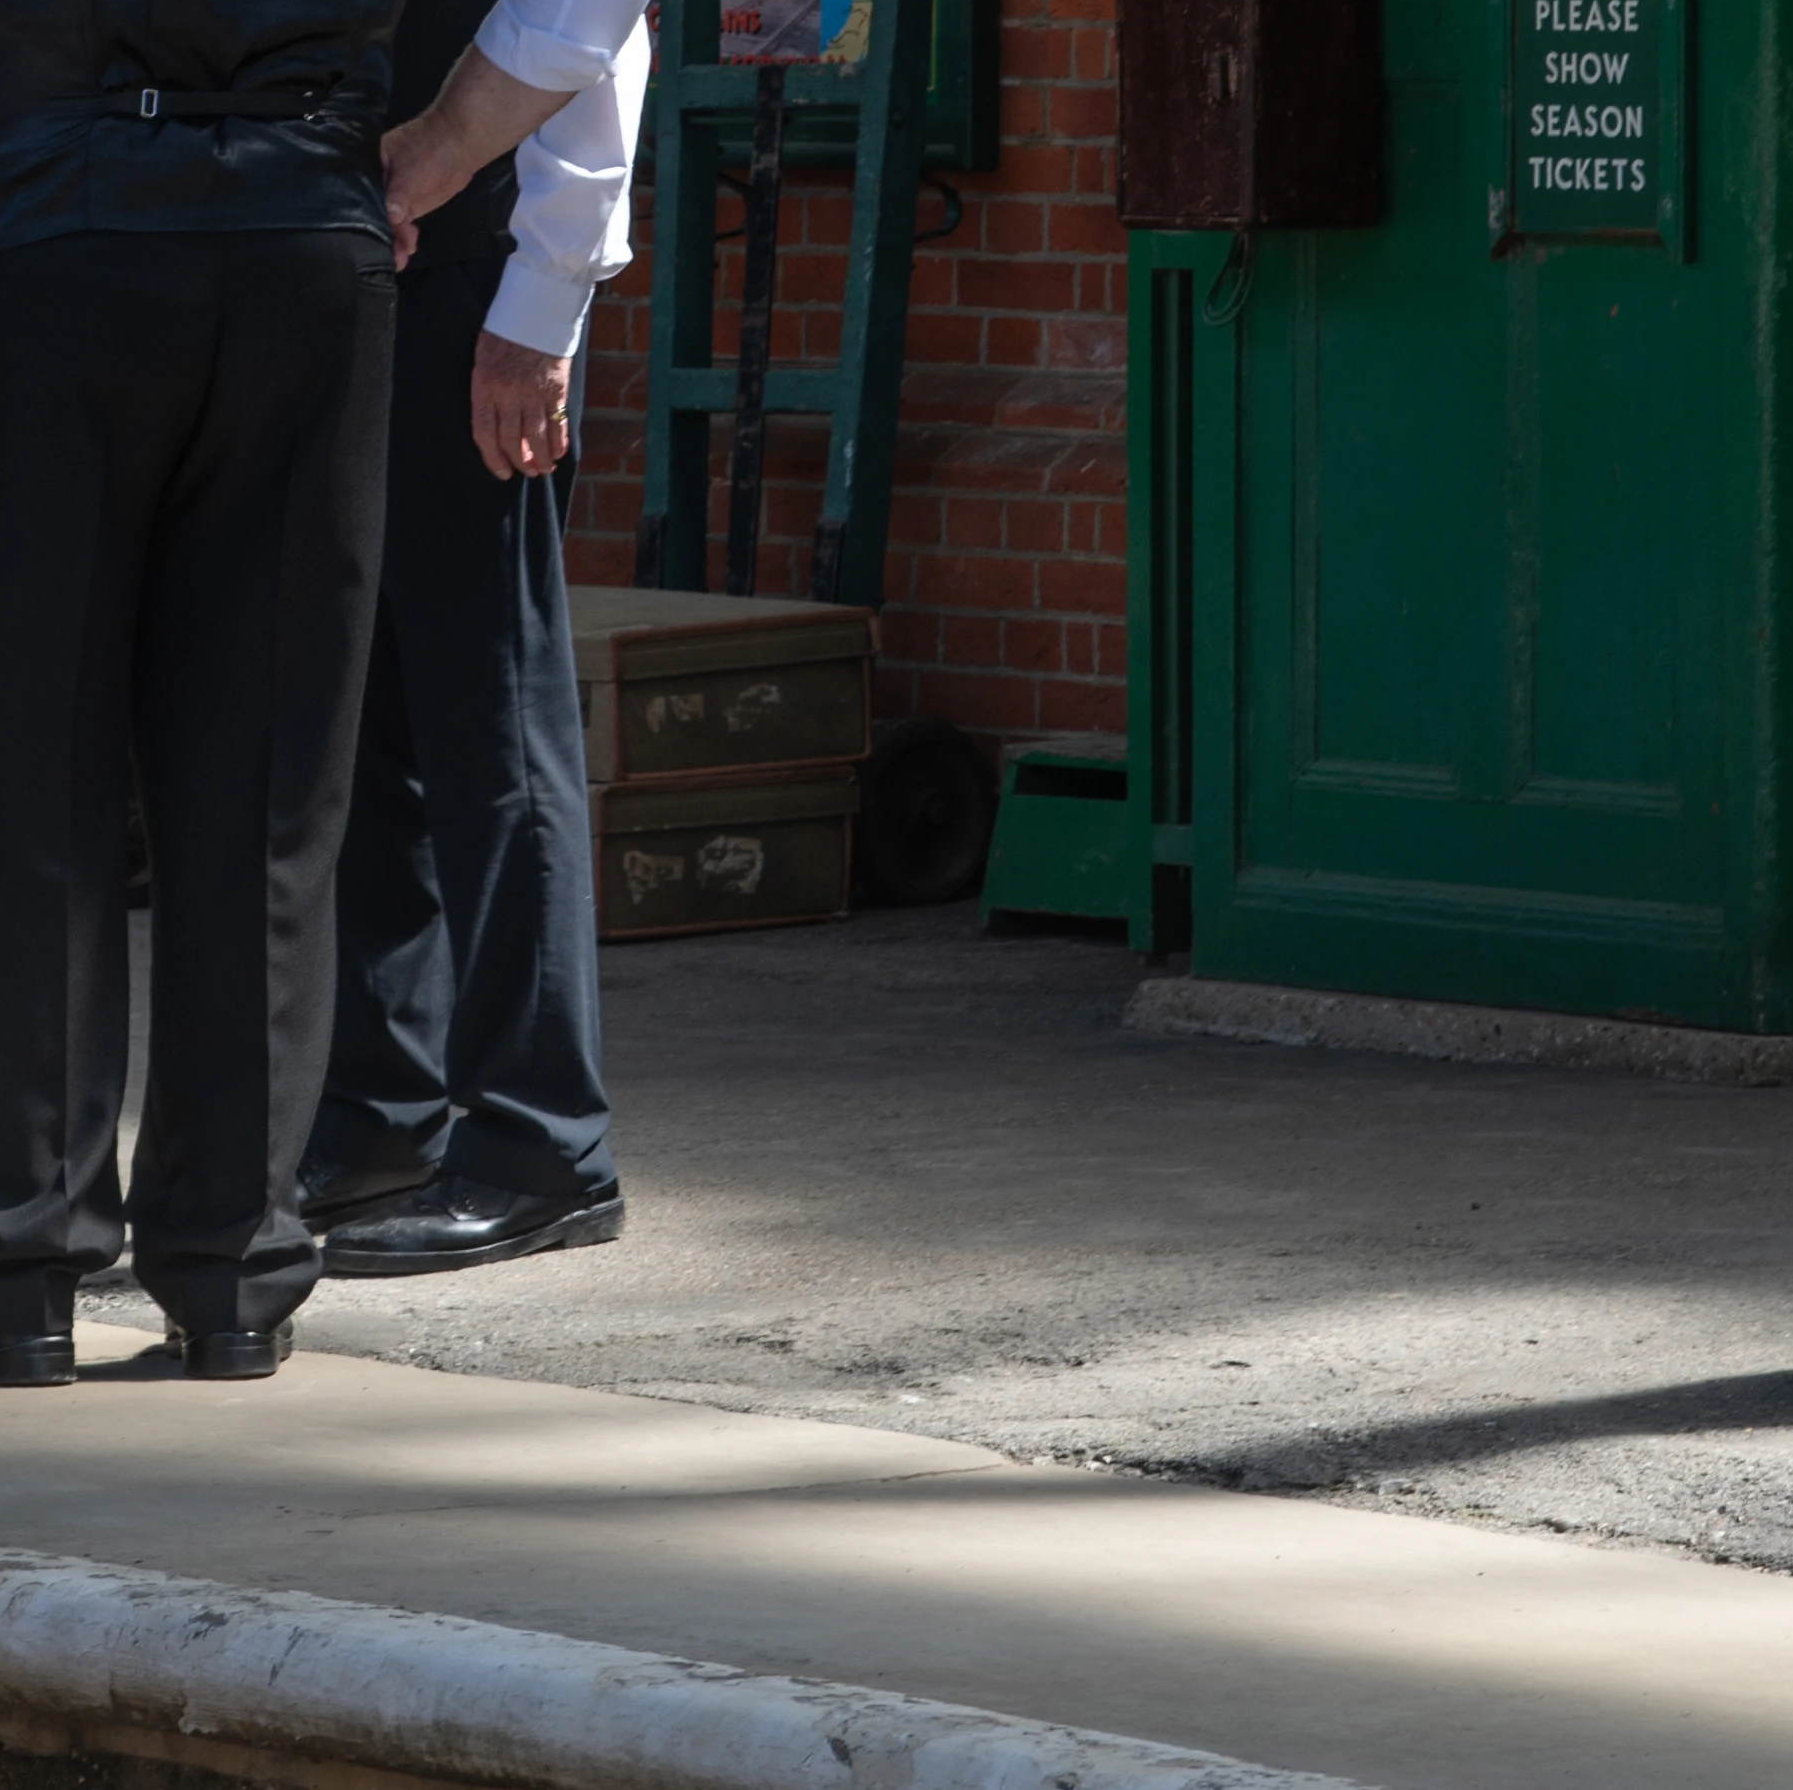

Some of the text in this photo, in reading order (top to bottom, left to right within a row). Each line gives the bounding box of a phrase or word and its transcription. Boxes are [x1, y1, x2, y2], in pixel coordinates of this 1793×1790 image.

[1544, 51, 1629, 85] SHOW
[1530, 104, 1643, 139] SEASON
[1528, 156, 1646, 192] TICKETS
